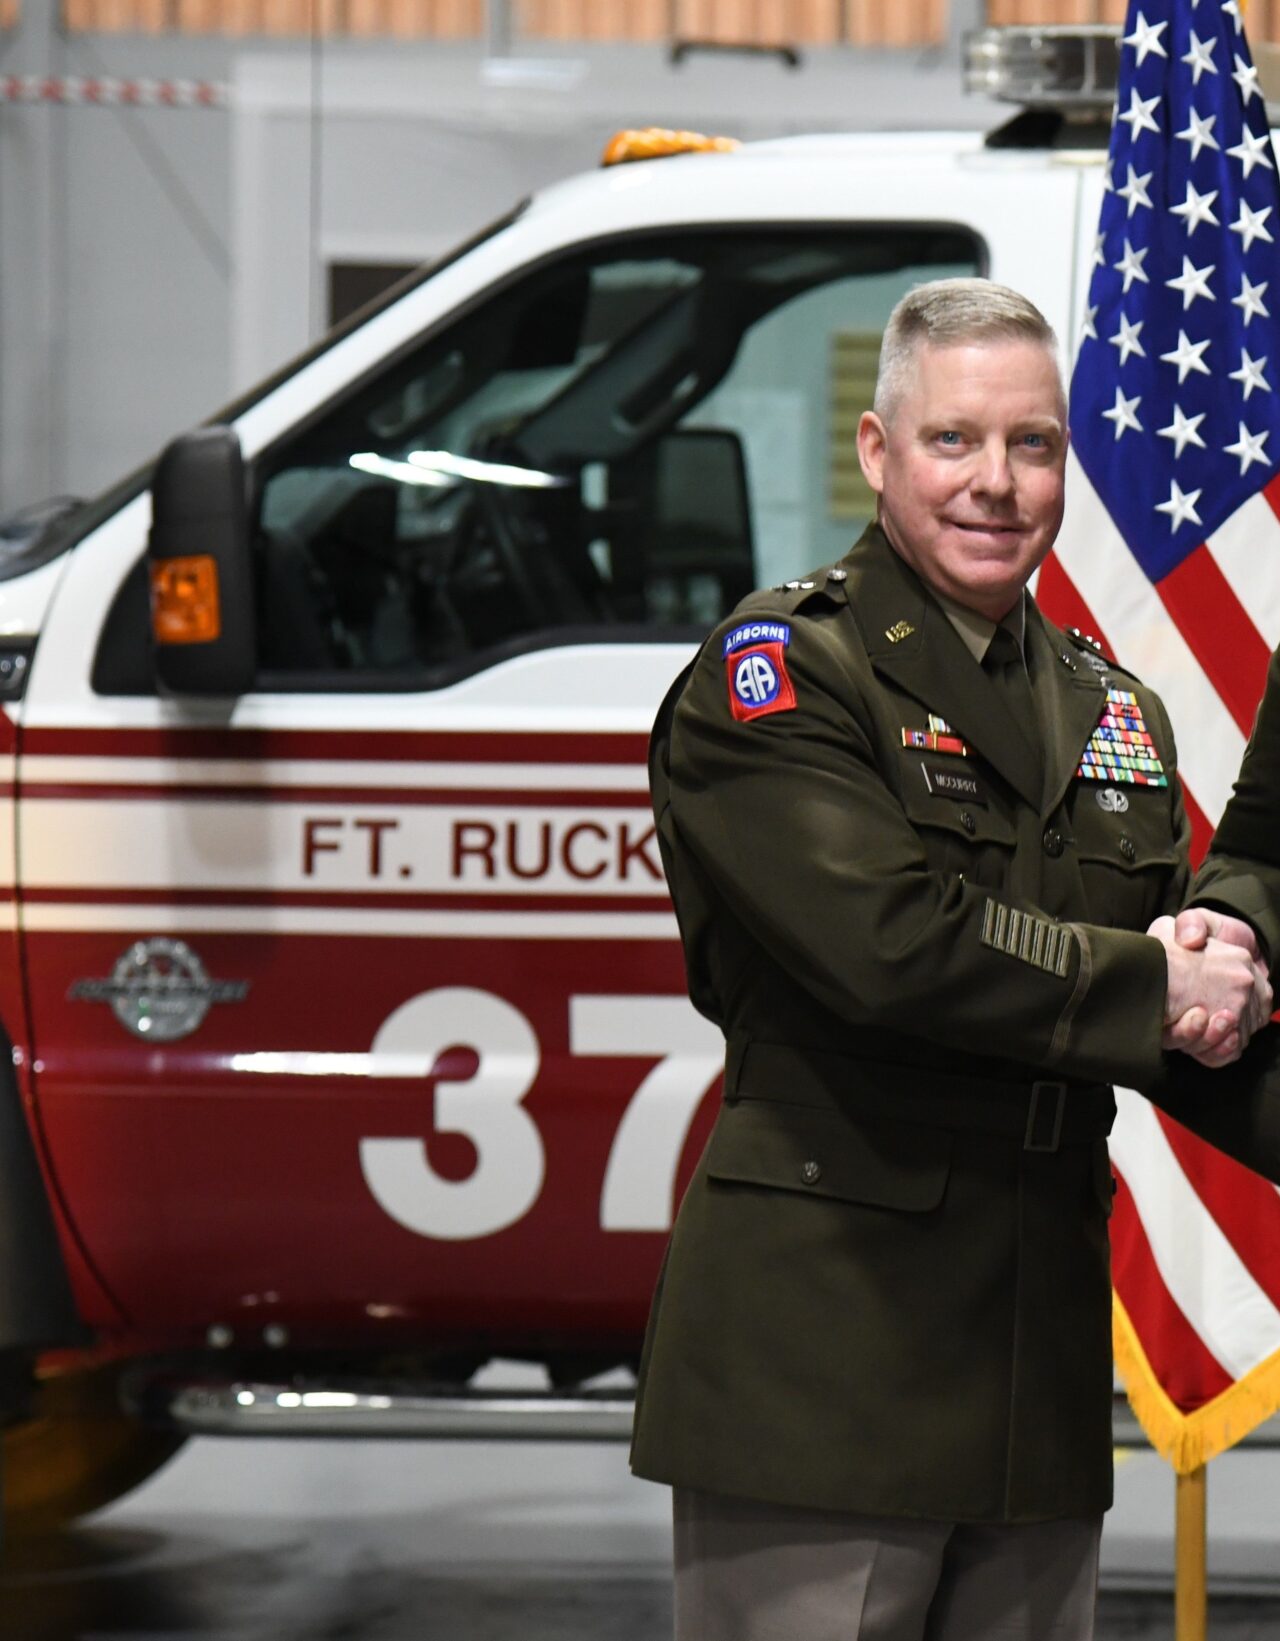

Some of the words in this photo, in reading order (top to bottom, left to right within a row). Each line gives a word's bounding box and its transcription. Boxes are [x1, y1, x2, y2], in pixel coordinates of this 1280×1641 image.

[725, 625, 786, 653] AIRBORNE
[735, 655, 776, 703] AA
[302, 816, 412, 880] FT.
[358, 985, 728, 1242] 37
